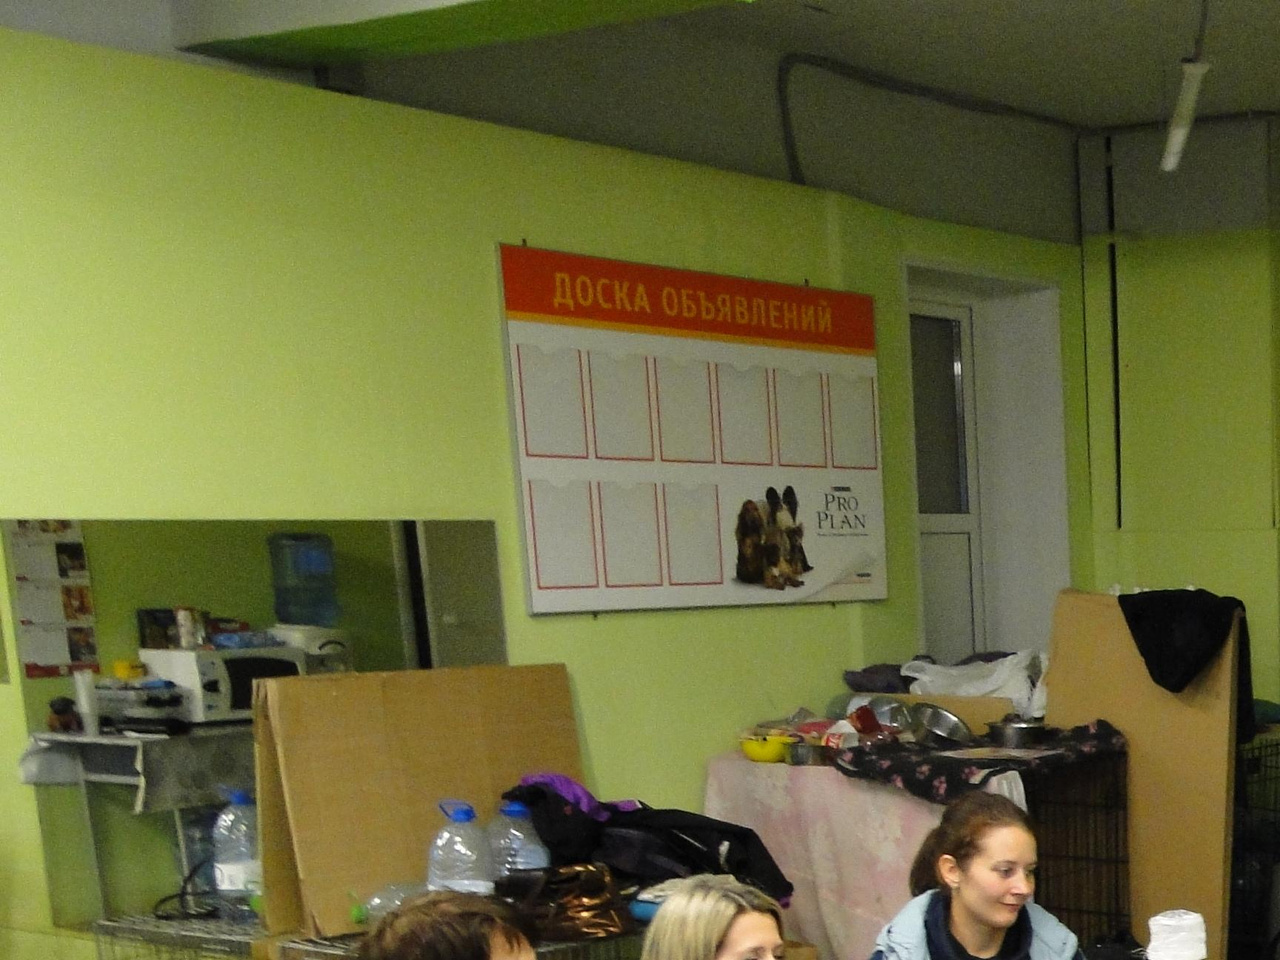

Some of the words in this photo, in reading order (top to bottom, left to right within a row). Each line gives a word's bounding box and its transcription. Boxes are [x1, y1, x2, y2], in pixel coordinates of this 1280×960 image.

[553, 272, 652, 314] ДОСКА
[661, 286, 832, 334] ОБЪЯВЛЕНИЙ
[824, 493, 859, 512] PRO
[816, 511, 866, 530] PLAN
